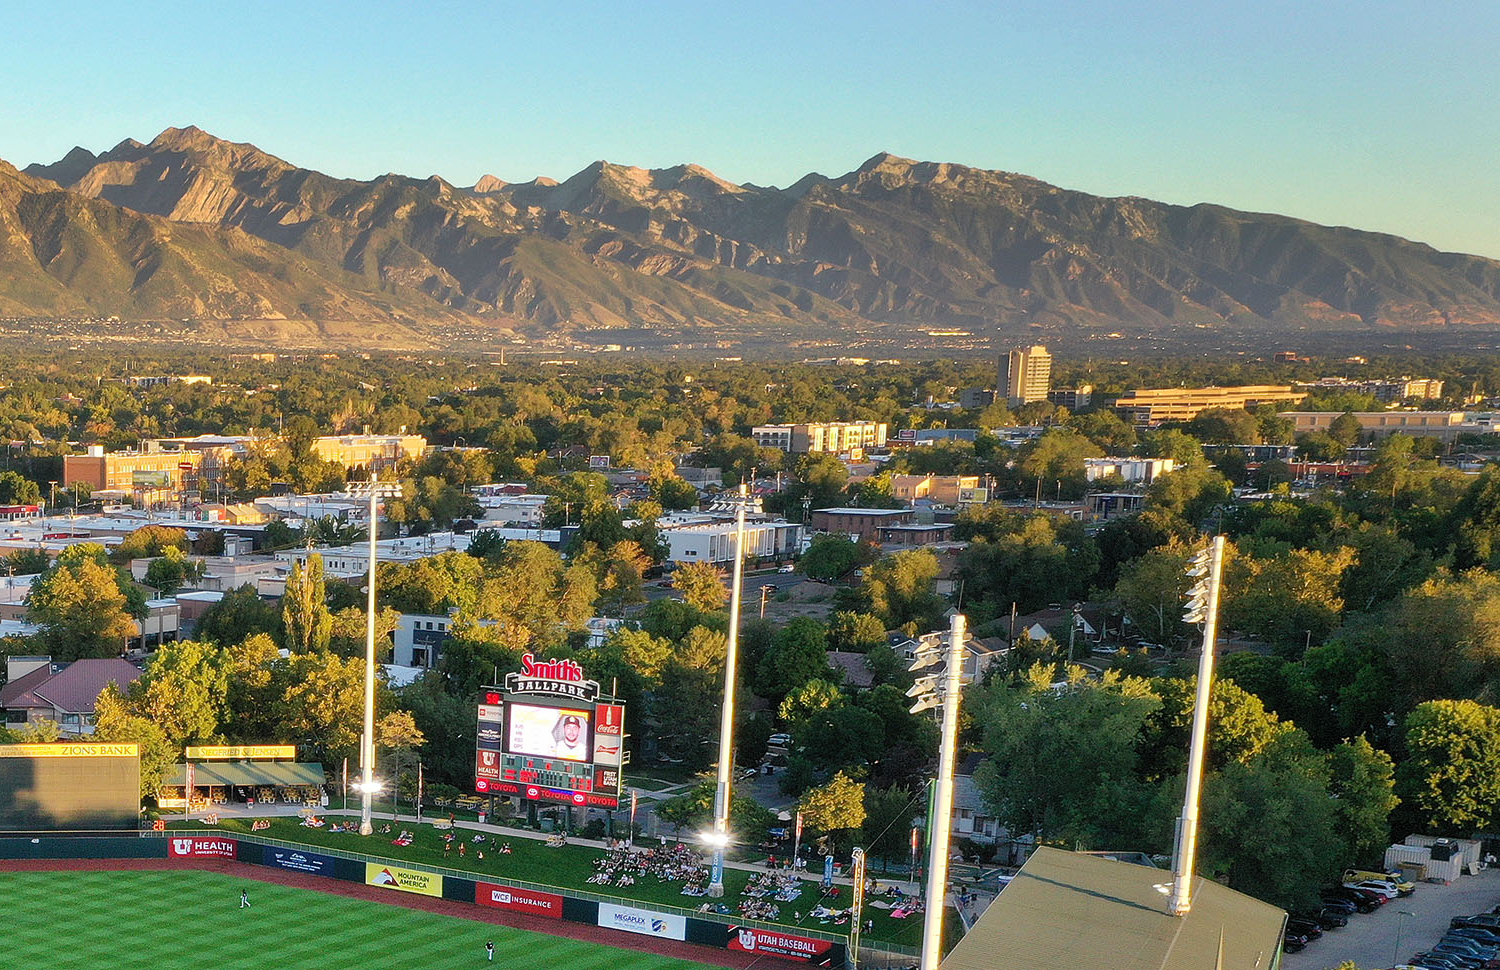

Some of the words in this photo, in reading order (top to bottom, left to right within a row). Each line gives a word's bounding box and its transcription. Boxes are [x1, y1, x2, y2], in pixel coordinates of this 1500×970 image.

[521, 653, 582, 682] Smith's
[517, 681, 586, 698] BALLPARK
[61, 746, 96, 755] ZIONS
[100, 745, 132, 755] BANK
[478, 767, 499, 775] HEALTH
[490, 782, 519, 793] TOYOTA
[540, 790, 571, 800] TOYOTA
[587, 795, 618, 806] TOYOTA
[153, 820, 165, 831] 28
[195, 841, 233, 852] HEALTH
[397, 872, 430, 883] MOUNTAIN
[400, 879, 427, 889] AMERICA
[511, 896, 552, 909] INSURANCE
[614, 912, 646, 925] MEGAPLEX
[758, 934, 777, 945] UTAH
[778, 937, 817, 953] BASEBALL
